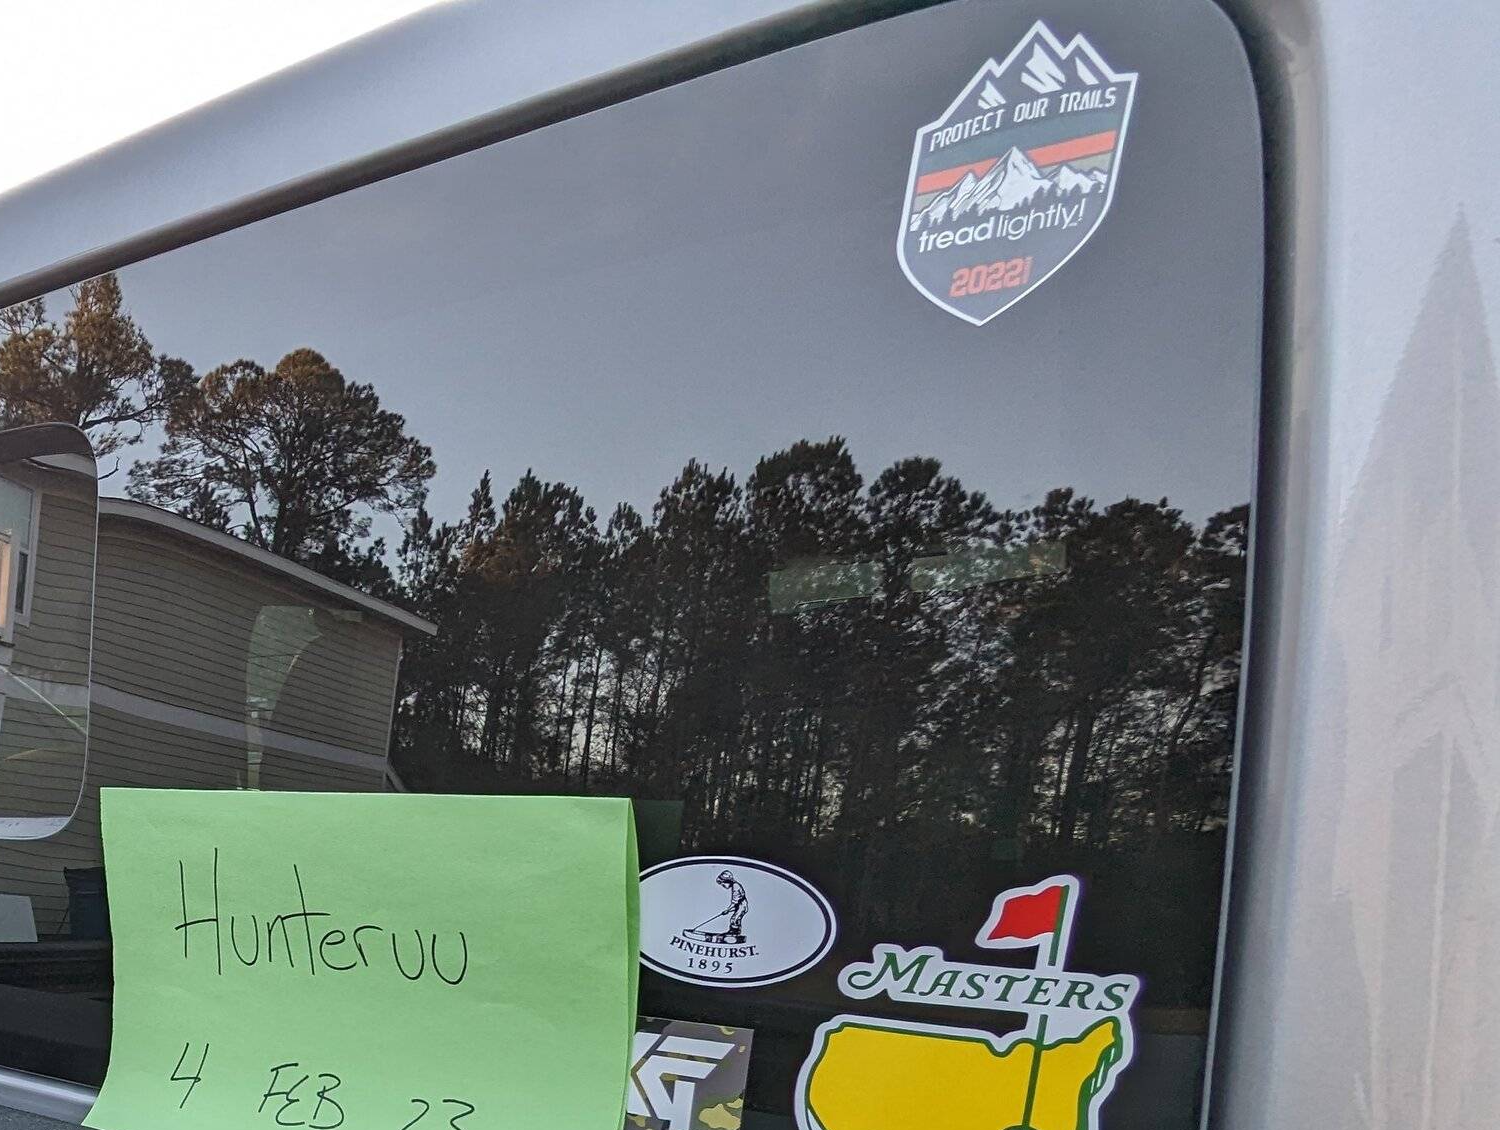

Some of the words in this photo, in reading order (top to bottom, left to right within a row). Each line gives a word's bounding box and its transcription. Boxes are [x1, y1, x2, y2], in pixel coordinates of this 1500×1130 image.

[929, 109, 1006, 151] PROTECT
[1013, 98, 1049, 123] OUR
[1059, 87, 1117, 114] TRAILS
[687, 957, 733, 974] 1895
[169, 1042, 209, 1109] 4
[258, 1063, 345, 1129] FEB
